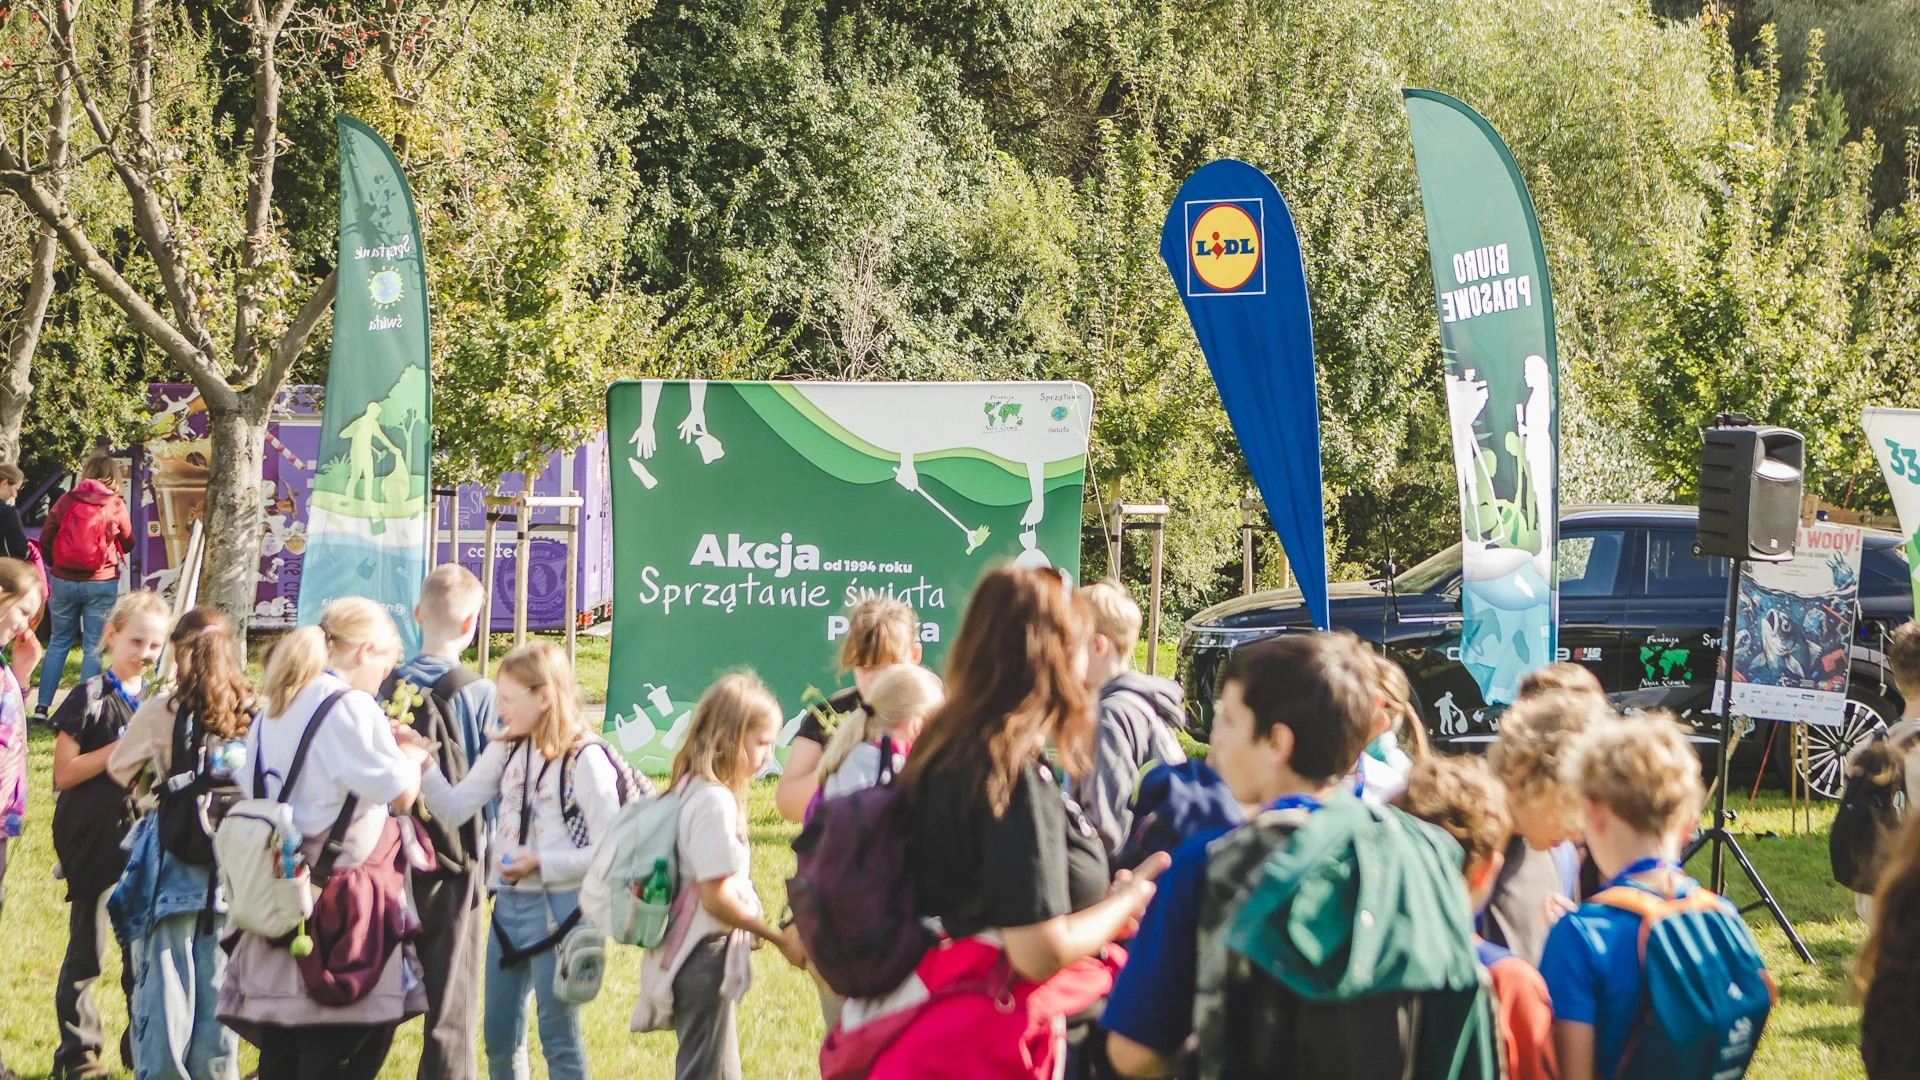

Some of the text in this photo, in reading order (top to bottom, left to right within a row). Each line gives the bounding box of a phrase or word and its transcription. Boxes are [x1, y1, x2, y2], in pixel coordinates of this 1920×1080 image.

[690, 532, 913, 578] Akcja od 1994 roku
[1807, 529, 1861, 556] wody!
[639, 566, 831, 616] Sprzątanie
